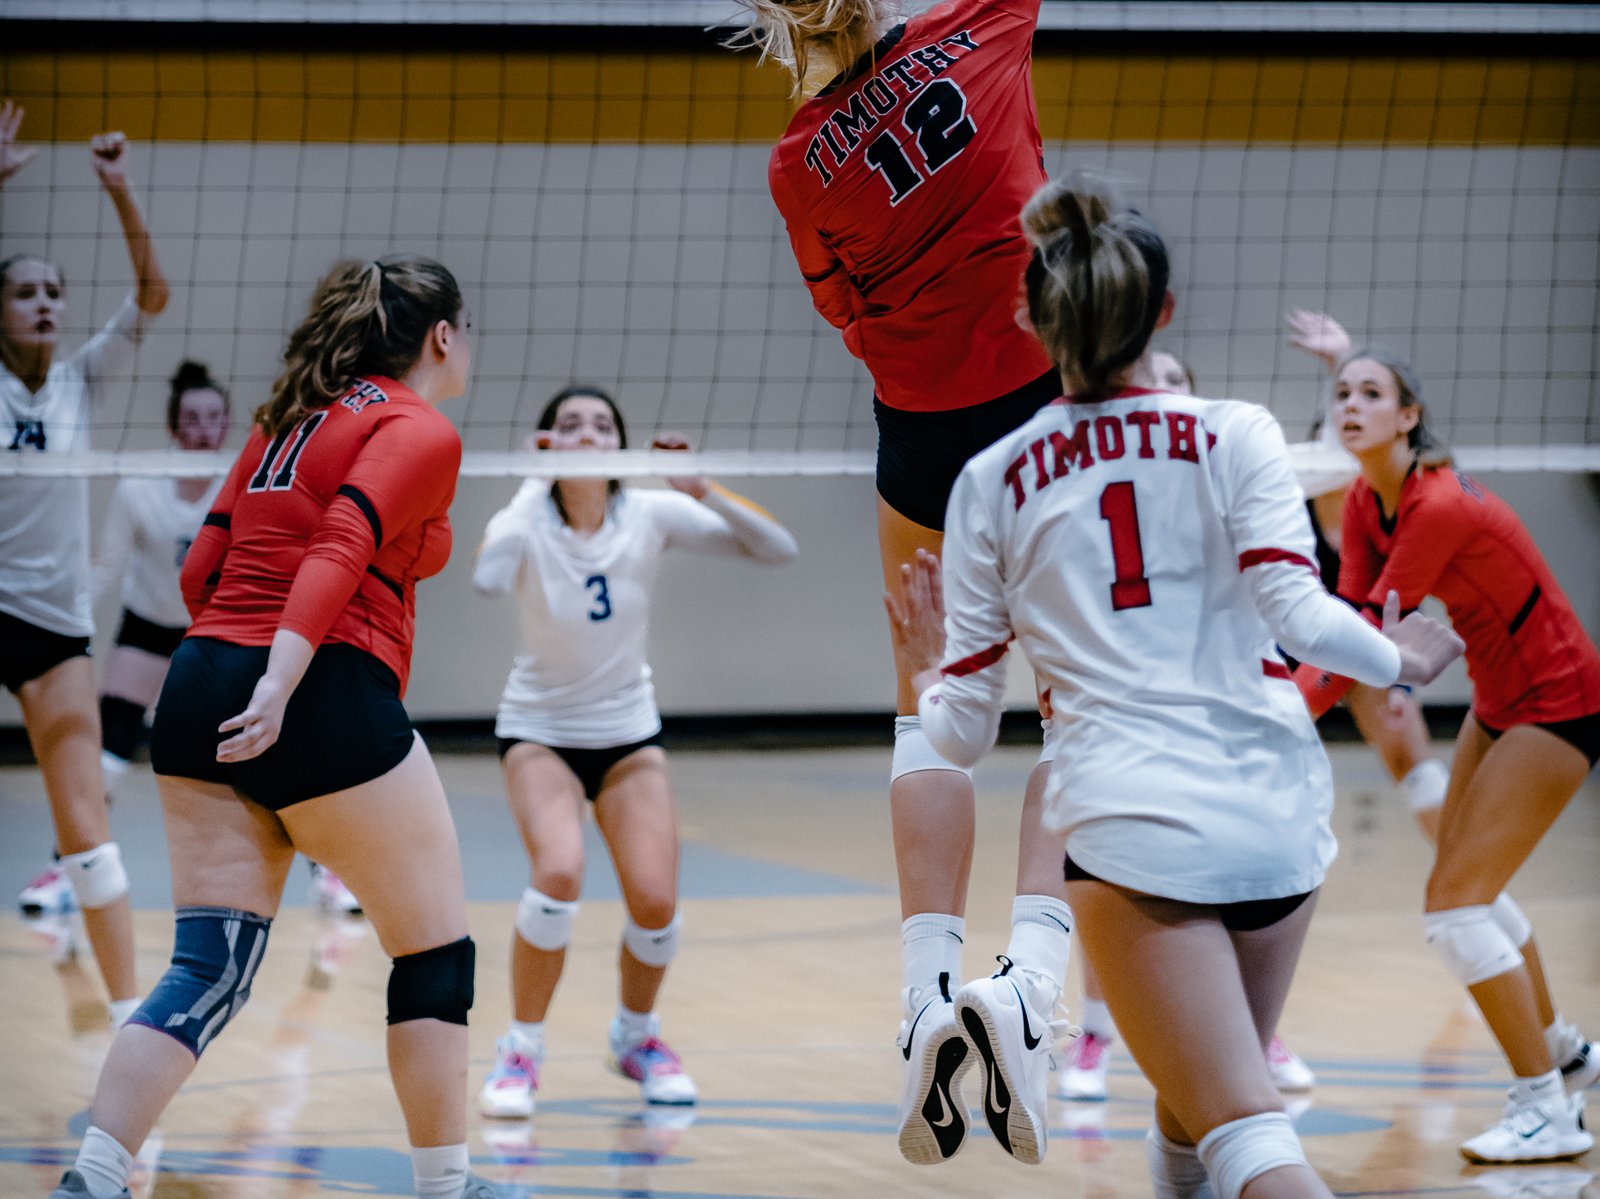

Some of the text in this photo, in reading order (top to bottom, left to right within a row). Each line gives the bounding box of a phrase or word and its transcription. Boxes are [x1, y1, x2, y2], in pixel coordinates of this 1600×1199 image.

[804, 30, 979, 188] TIMOTHY
[864, 77, 977, 208] 12
[247, 410, 329, 493] 11
[585, 574, 612, 622] 3
[1098, 480, 1152, 611] 1
